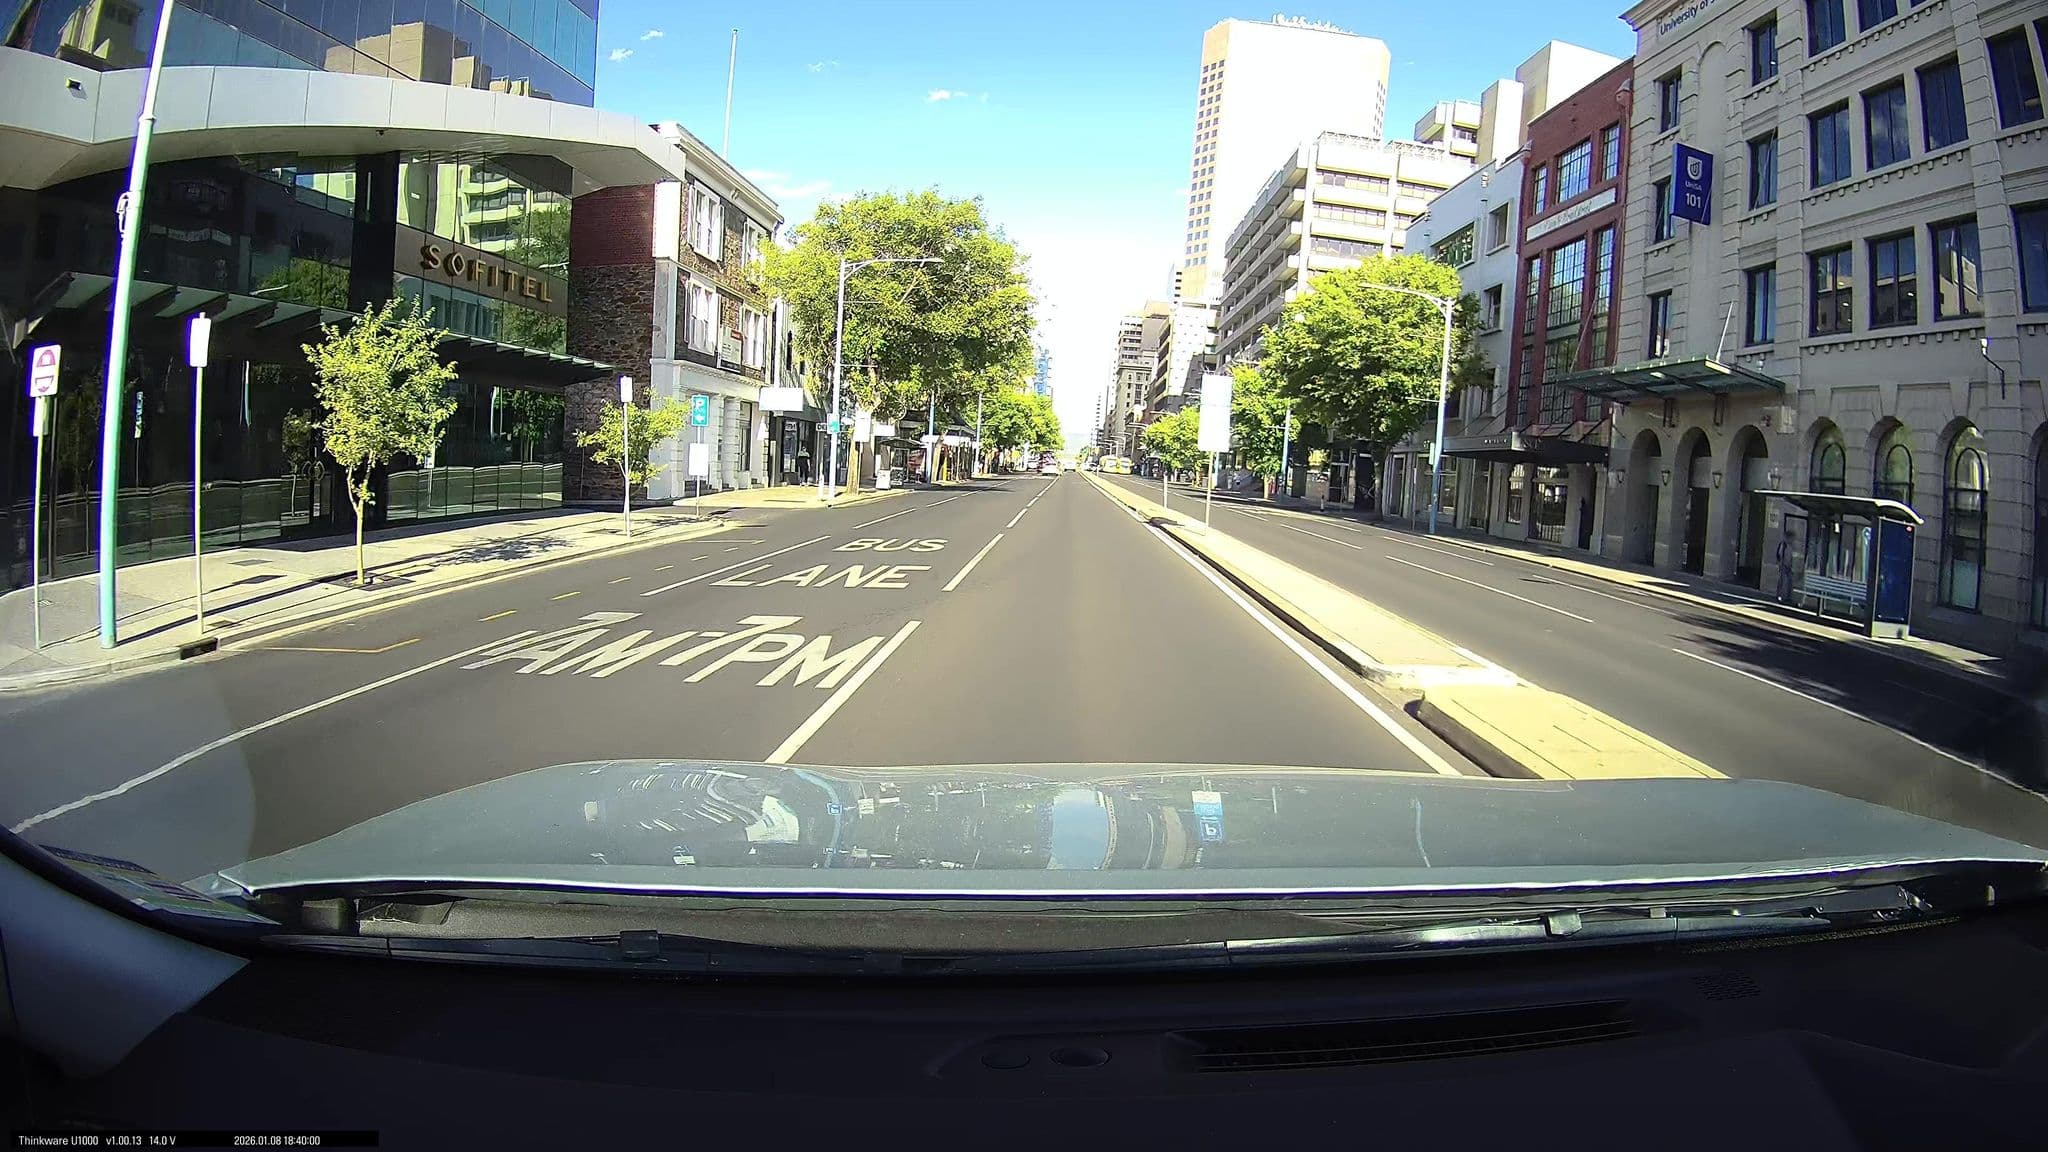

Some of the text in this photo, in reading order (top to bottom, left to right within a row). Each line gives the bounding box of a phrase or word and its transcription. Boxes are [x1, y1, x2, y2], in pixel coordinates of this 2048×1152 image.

[1660, 5, 1698, 35] University
[1685, 193, 1701, 209] 101
[421, 244, 553, 302] SOFITEL
[832, 538, 949, 552] BUS
[708, 564, 932, 589] LANE
